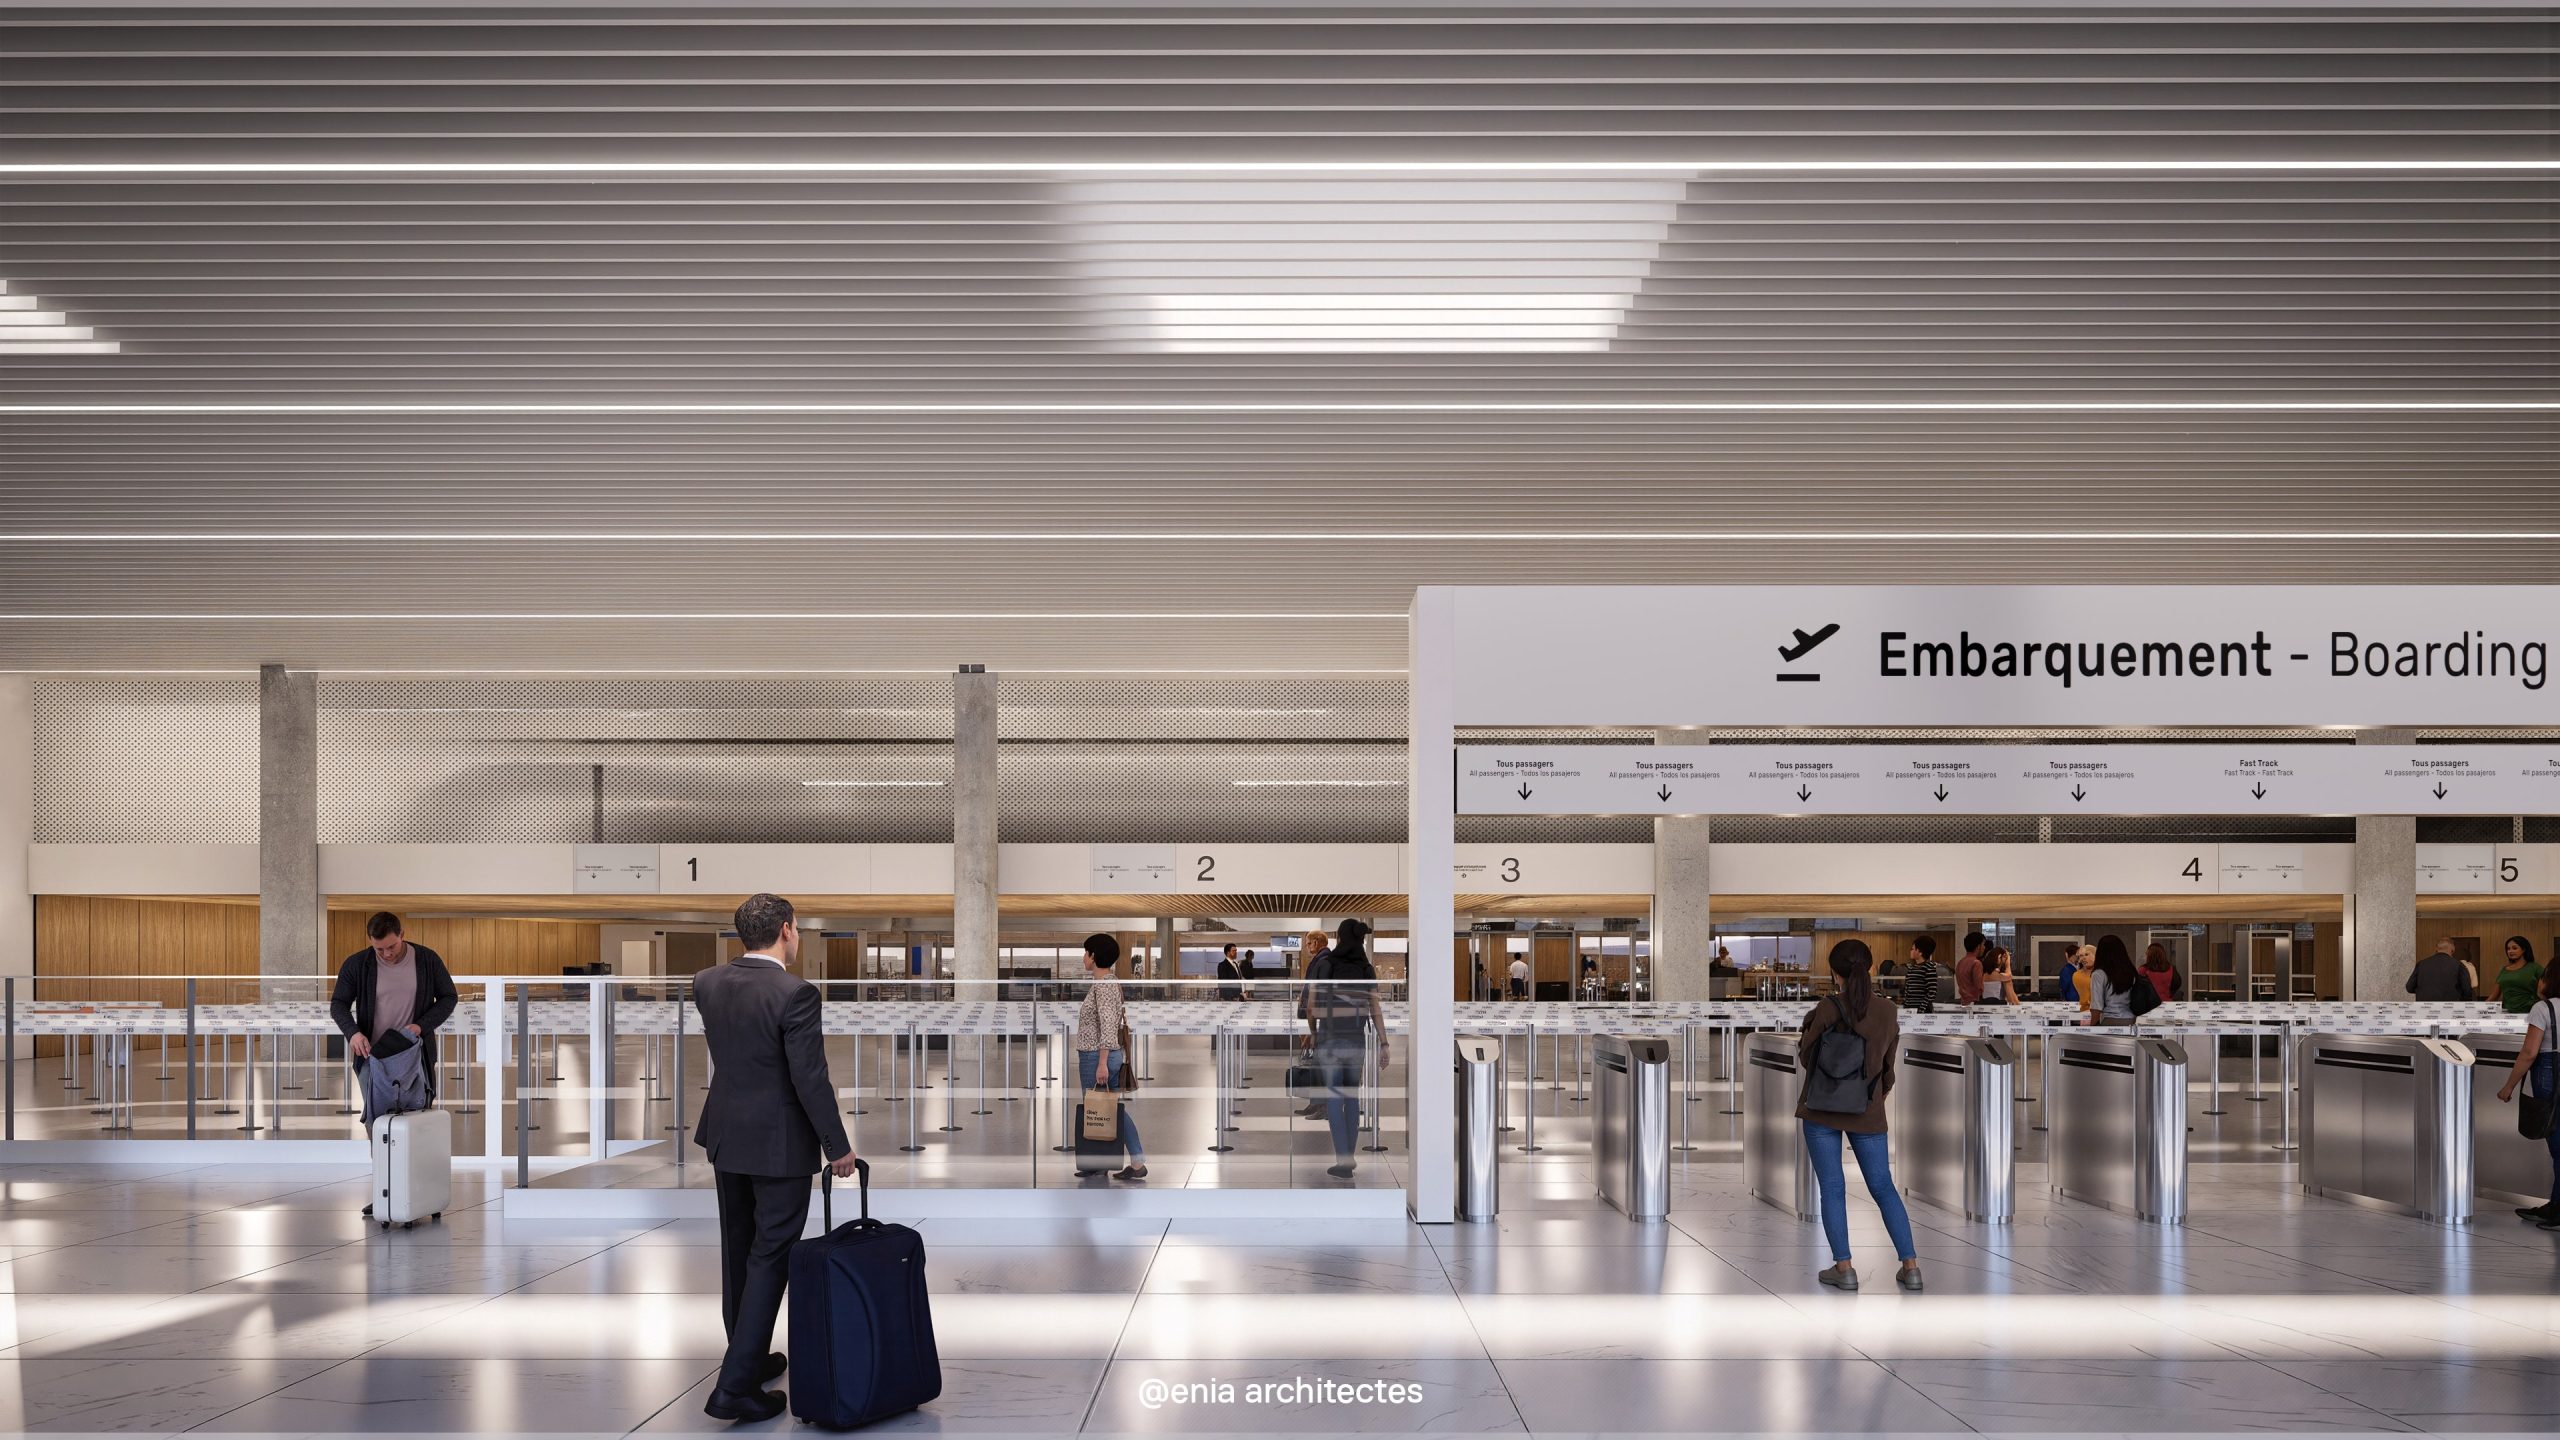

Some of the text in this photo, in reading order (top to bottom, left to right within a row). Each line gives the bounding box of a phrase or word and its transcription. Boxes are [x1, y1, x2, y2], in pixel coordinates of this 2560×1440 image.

[1880, 630, 2547, 691] Embarquement - Boarding
[1496, 759, 1555, 770] Tous passagers
[1636, 761, 1695, 772] Tous passagers
[1775, 761, 1834, 772] Tous passagers
[1912, 761, 1971, 772] Tous passagers
[2049, 761, 2108, 772] Tous passagers
[2239, 759, 2279, 768] Fast Track
[2411, 759, 2470, 770] Tous passagers
[1469, 769, 1478, 777] All
[1479, 770, 1515, 778] passengers
[1520, 769, 1539, 777] Todos
[1540, 769, 1550, 777] los
[1550, 769, 1581, 778] pasajeros
[1609, 771, 1618, 779] All
[1619, 772, 1655, 780] passengers
[1660, 771, 1679, 779] Todos
[1680, 771, 1690, 779] los
[1690, 771, 1721, 780] pasajeros
[1748, 771, 1757, 779] All
[1758, 772, 1794, 780] passengers
[1799, 771, 1818, 779] Todos
[1819, 771, 1829, 779] los
[1829, 771, 1860, 780] pasajeros
[1885, 771, 1894, 779] All
[1895, 772, 1931, 780] passengers
[1936, 771, 1955, 779] Todos
[1956, 771, 1966, 779] los
[1966, 771, 1997, 780] pasajeros
[2022, 771, 2031, 779] All
[2032, 772, 2068, 780] passengers
[2073, 771, 2092, 779] Todos
[2093, 771, 2103, 779] los
[2103, 771, 2134, 780] pasajeros
[2224, 769, 2239, 777] Fast
[2240, 769, 2257, 777] Track
[2262, 769, 2276, 777] Fast
[2276, 769, 2294, 777] Track
[2384, 769, 2393, 777] All
[2394, 770, 2430, 778] passengers
[2435, 769, 2454, 777] Todos
[2455, 769, 2465, 777] los
[2465, 769, 2496, 778] pasajeros
[2521, 769, 2531, 777] All
[687, 857, 697, 882] 1
[1197, 855, 1216, 882] 2
[1500, 856, 1521, 883] 3
[2181, 857, 2203, 882] 4
[2500, 857, 2519, 883] 5
